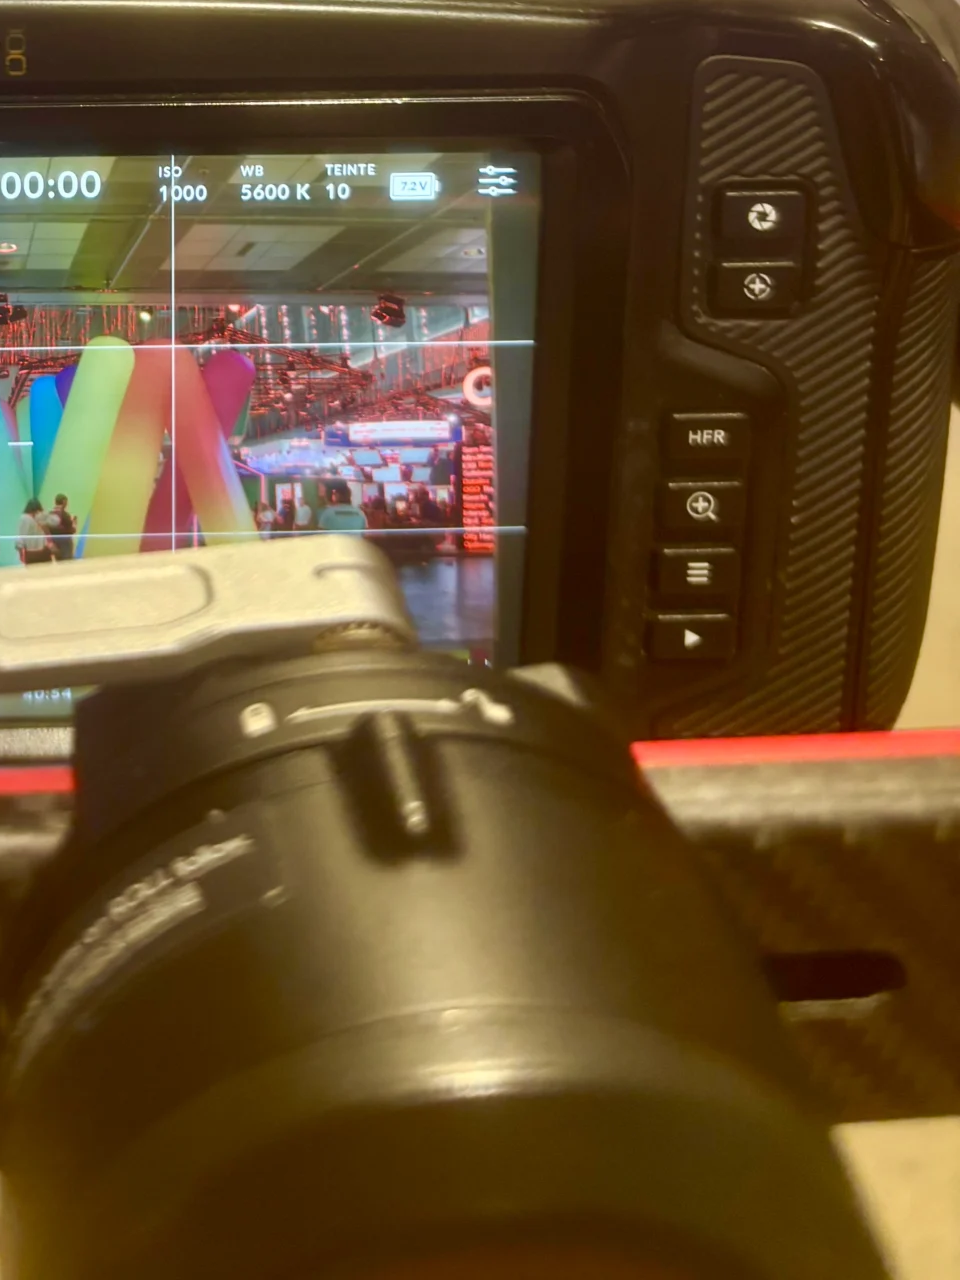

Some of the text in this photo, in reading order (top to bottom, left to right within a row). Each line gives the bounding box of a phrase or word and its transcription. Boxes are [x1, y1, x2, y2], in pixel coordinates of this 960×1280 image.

[158, 166, 183, 178] ISO
[240, 165, 264, 177] WB
[325, 163, 377, 176] TEINTE
[158, 185, 208, 202] 1000
[240, 183, 311, 200] 5600 K
[326, 183, 351, 200] 10
[688, 429, 726, 444] HFR
